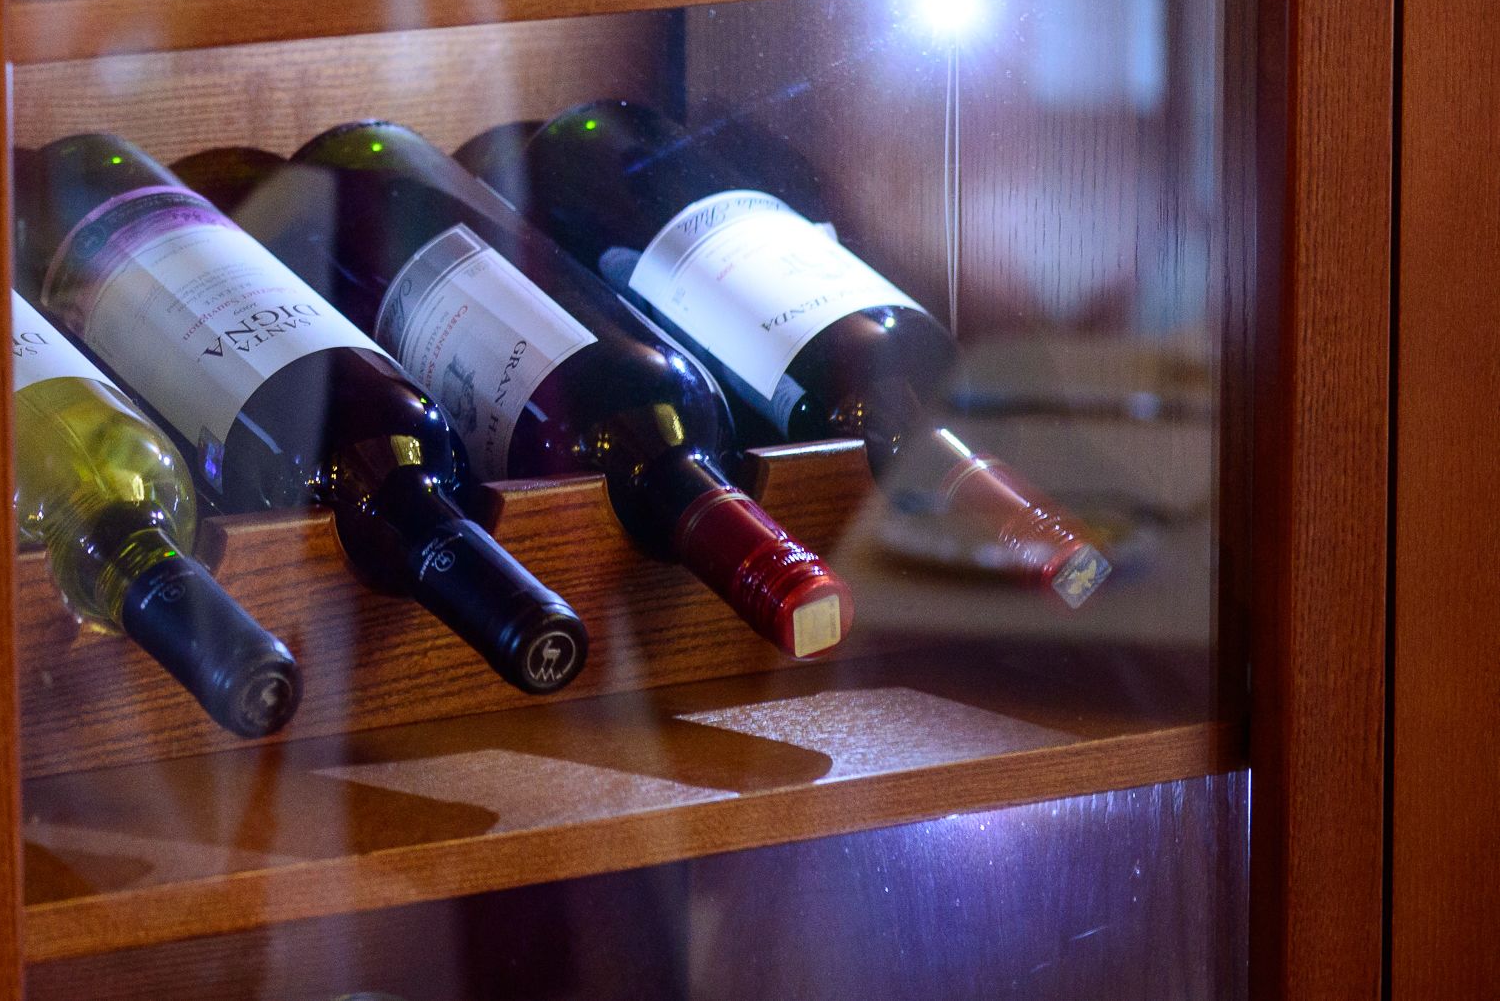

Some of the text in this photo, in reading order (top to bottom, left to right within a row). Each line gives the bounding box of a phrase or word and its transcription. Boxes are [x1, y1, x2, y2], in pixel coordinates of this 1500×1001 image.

[182, 298, 240, 341] Sauvignon
[201, 303, 322, 358] DIGNA
[236, 317, 312, 353] SANTA
[436, 304, 469, 359] CABERNET
[493, 339, 529, 407] GRAN
